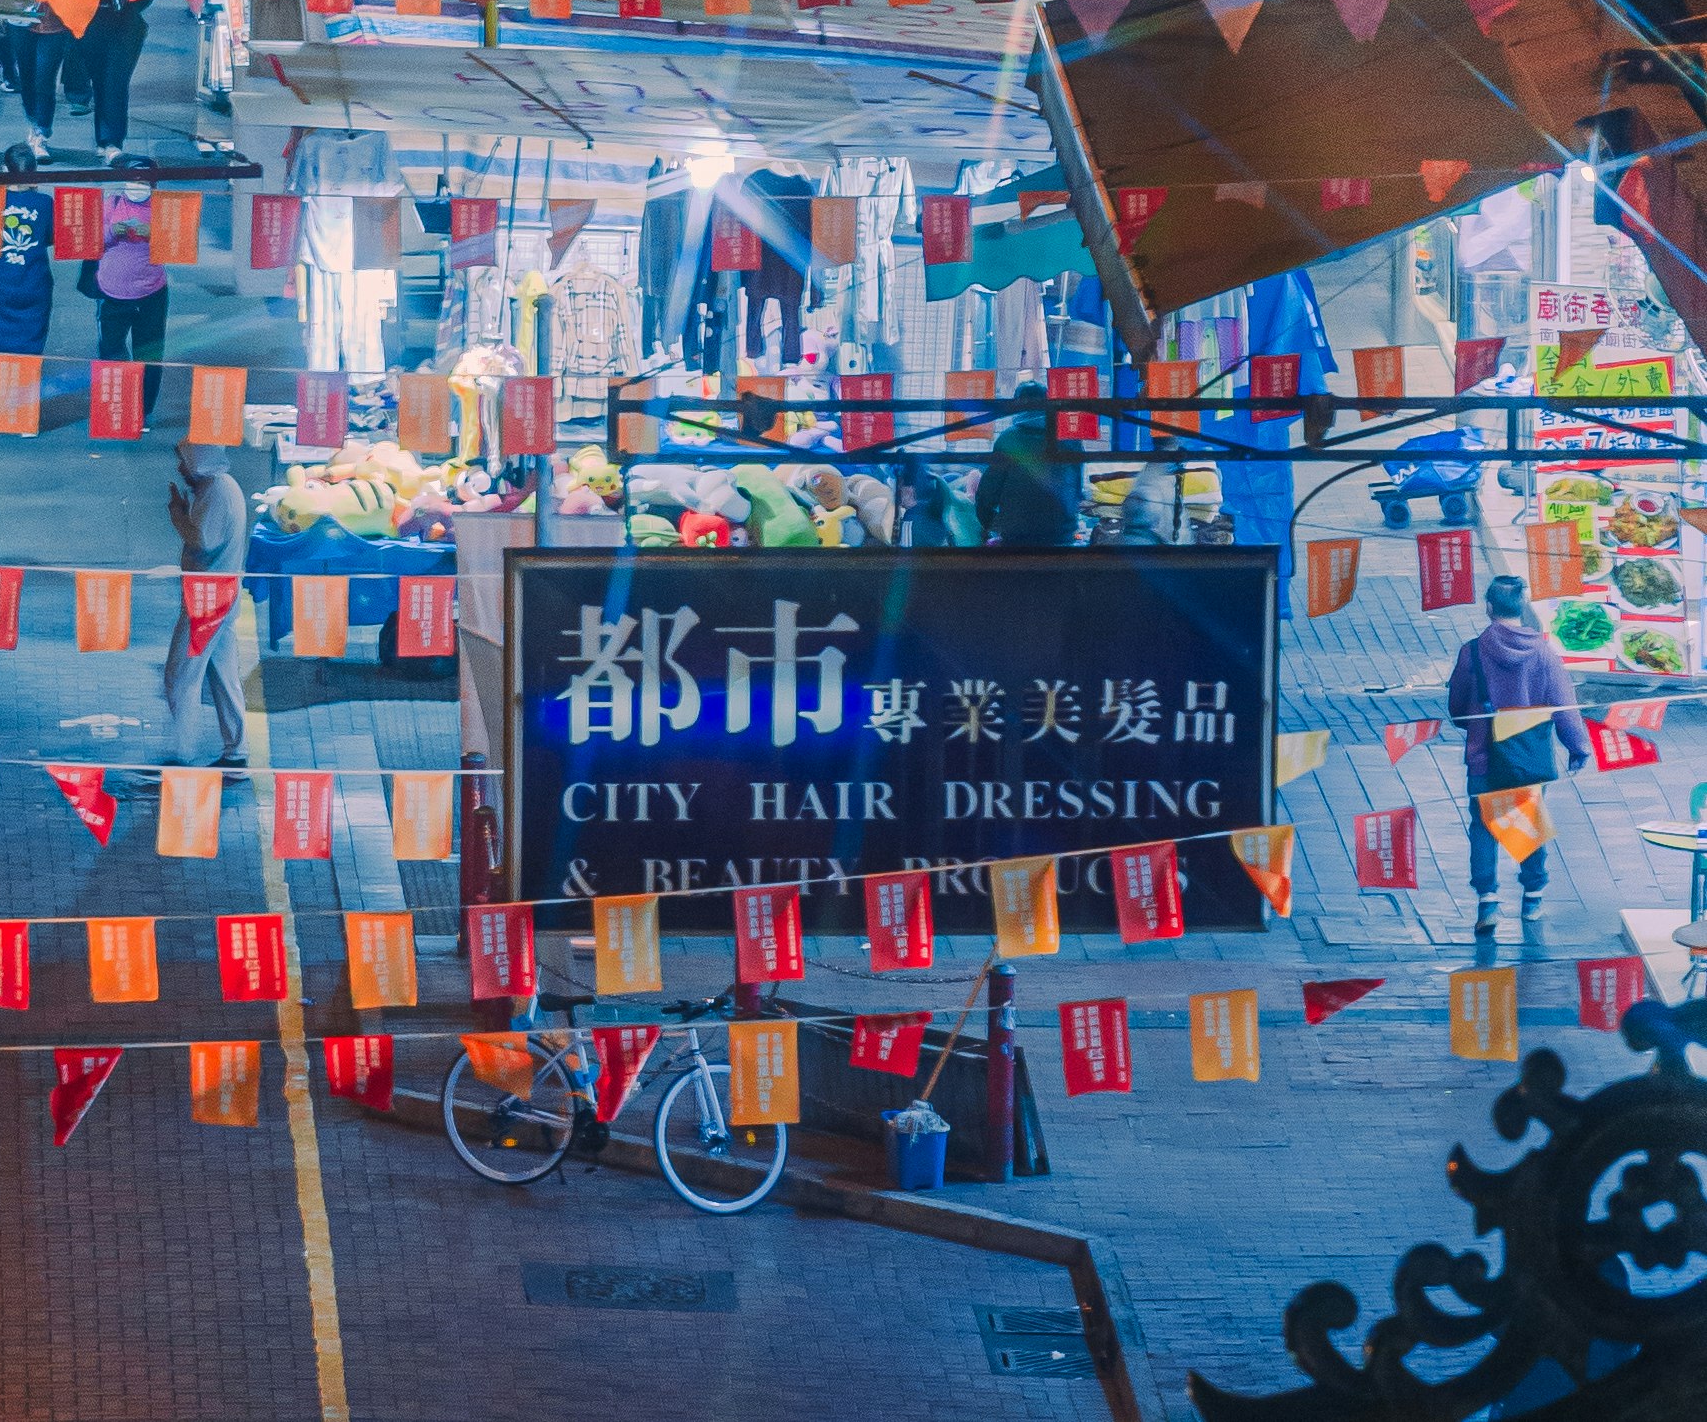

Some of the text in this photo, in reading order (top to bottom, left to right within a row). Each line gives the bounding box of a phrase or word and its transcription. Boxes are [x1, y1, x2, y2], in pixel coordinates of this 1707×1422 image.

[561, 779, 1224, 823] CITY HAIR DRESSING
